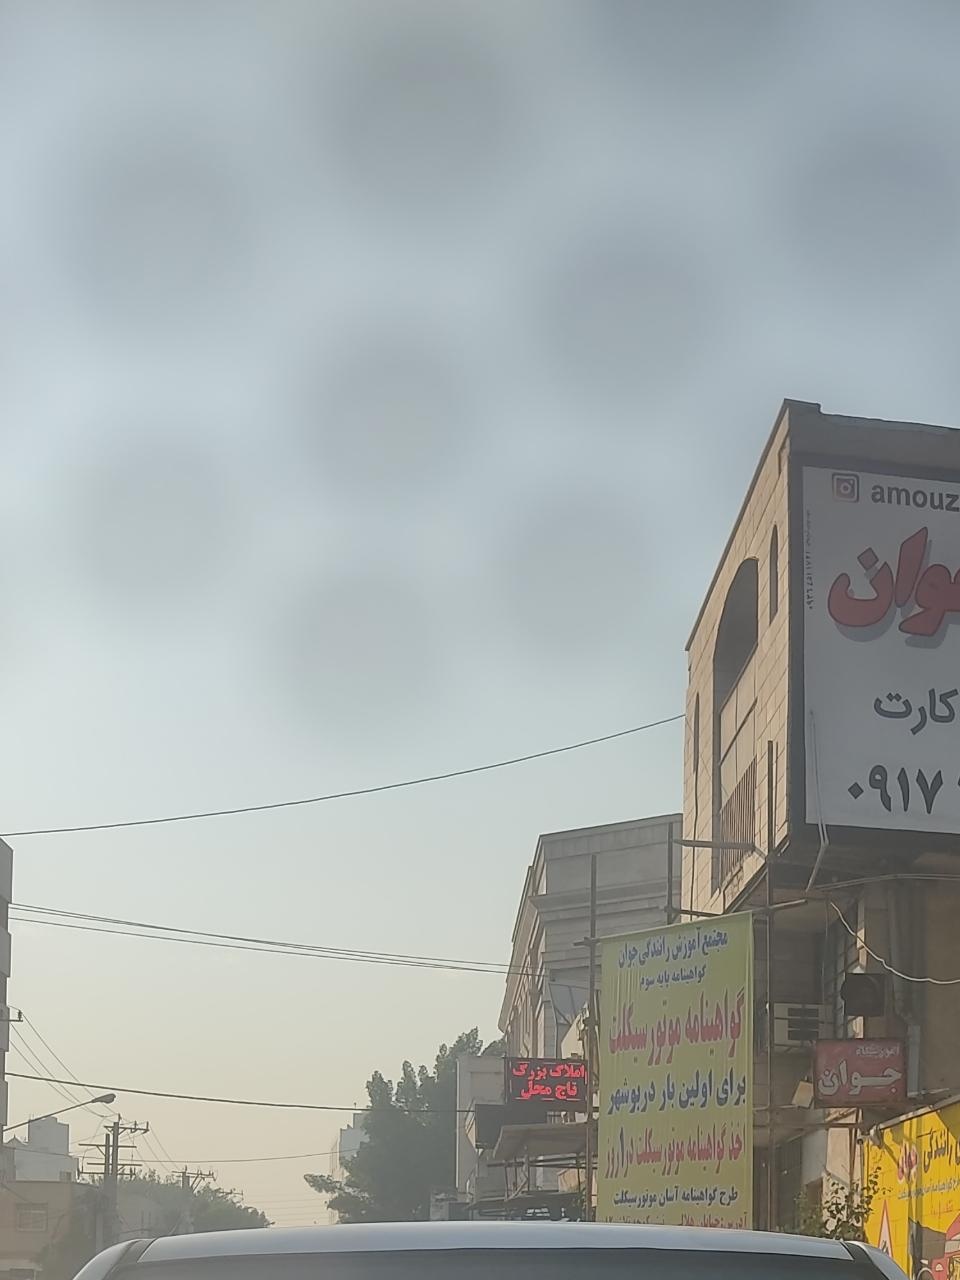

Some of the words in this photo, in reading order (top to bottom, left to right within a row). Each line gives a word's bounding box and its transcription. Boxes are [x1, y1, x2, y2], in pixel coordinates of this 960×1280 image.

[874, 688, 958, 735] کارت
[847, 763, 943, 815] ۰۹۱۷
[618, 942, 638, 968] جوان
[638, 935, 671, 966] رانندگی
[671, 927, 702, 960] آموزش
[702, 929, 728, 955] مجتمع
[685, 986, 745, 1058] گواهینامه
[512, 1063, 547, 1080] بزرگ
[550, 1063, 585, 1078] املاک
[716, 1067, 746, 1106] برای
[555, 1081, 577, 1099] تاج
[608, 1077, 641, 1115] بوشهر
[659, 1072, 675, 1111] بار
[678, 1068, 713, 1109] اولین
[688, 1121, 727, 1174] گواهینامه
[727, 1120, 746, 1160] اخذ
[659, 1186, 679, 1207] آسان
[681, 1187, 718, 1206] گواهینامه
[719, 1185, 738, 1207] طرح
